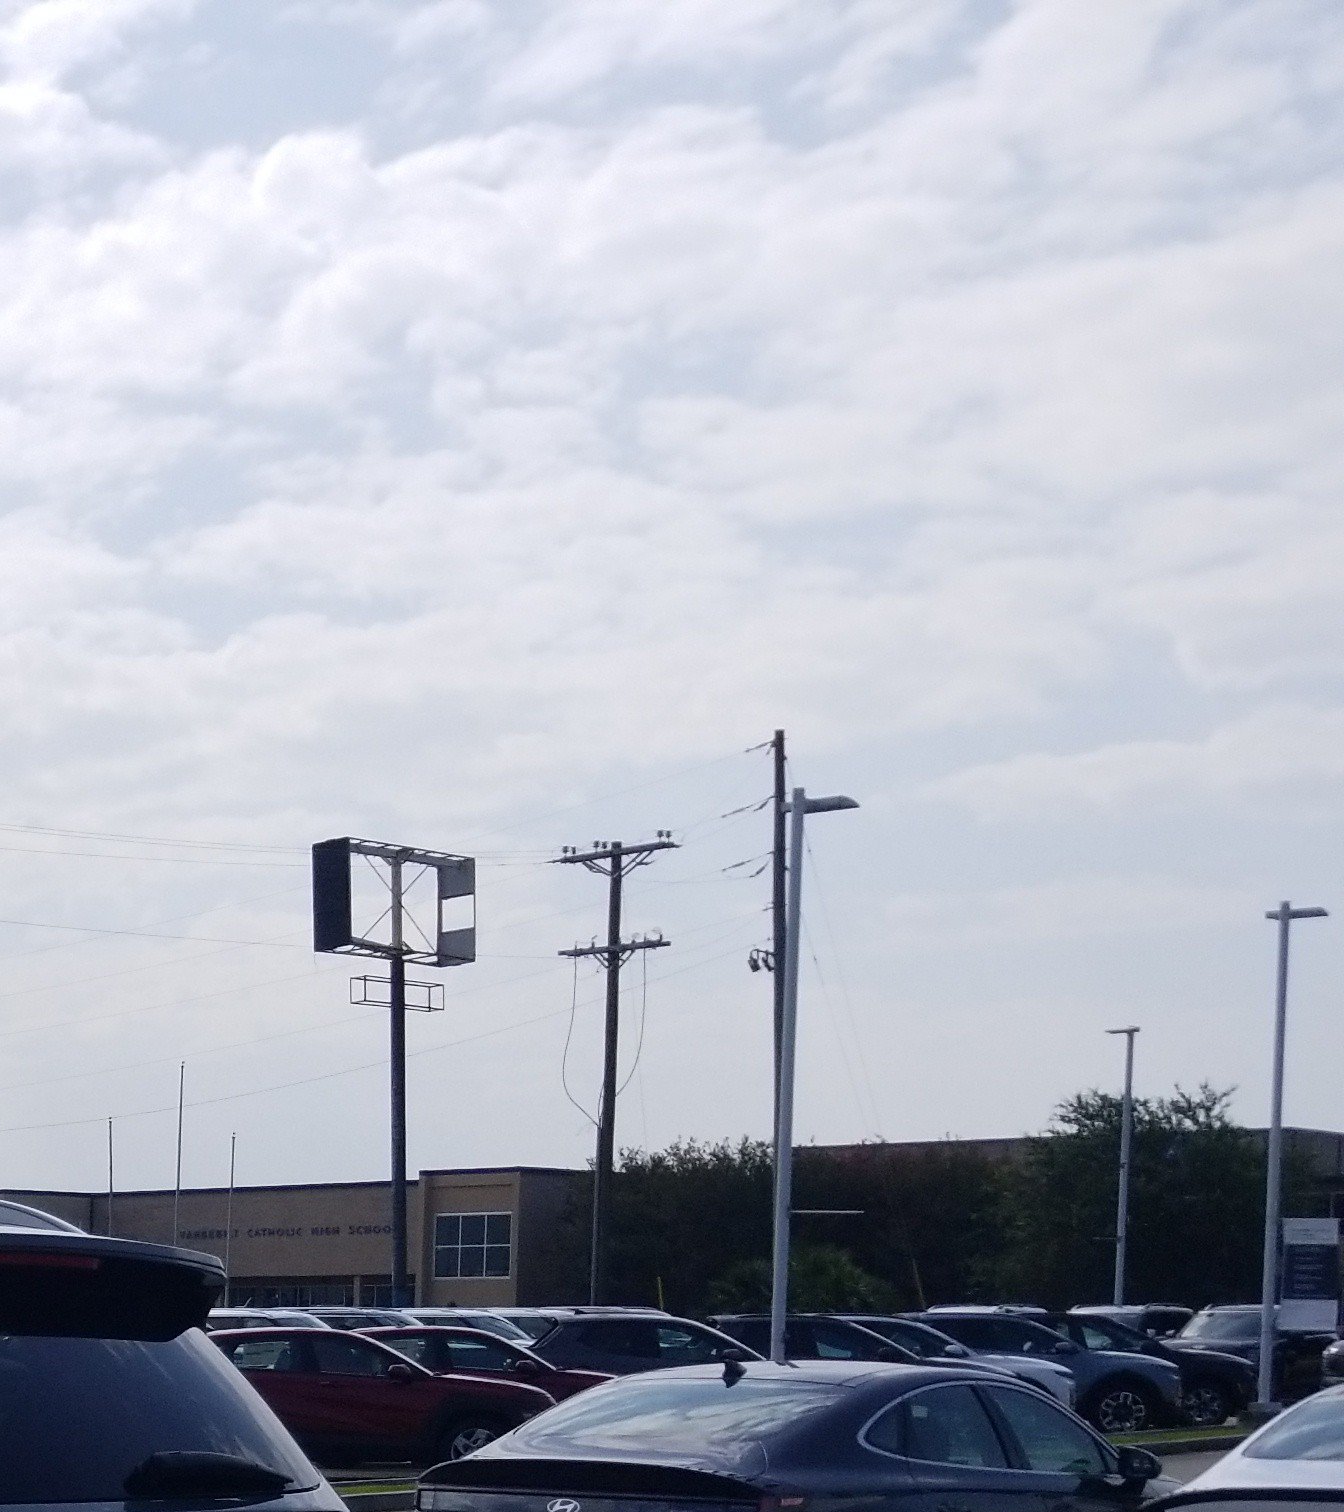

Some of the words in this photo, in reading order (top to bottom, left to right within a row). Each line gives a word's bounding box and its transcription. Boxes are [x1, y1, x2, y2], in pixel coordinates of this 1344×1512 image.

[179, 1228, 239, 1239] VANDEBIT
[247, 1226, 303, 1238] CATHOLIC
[311, 1226, 341, 1236] HIGH
[348, 1224, 393, 1236] SCHOO
